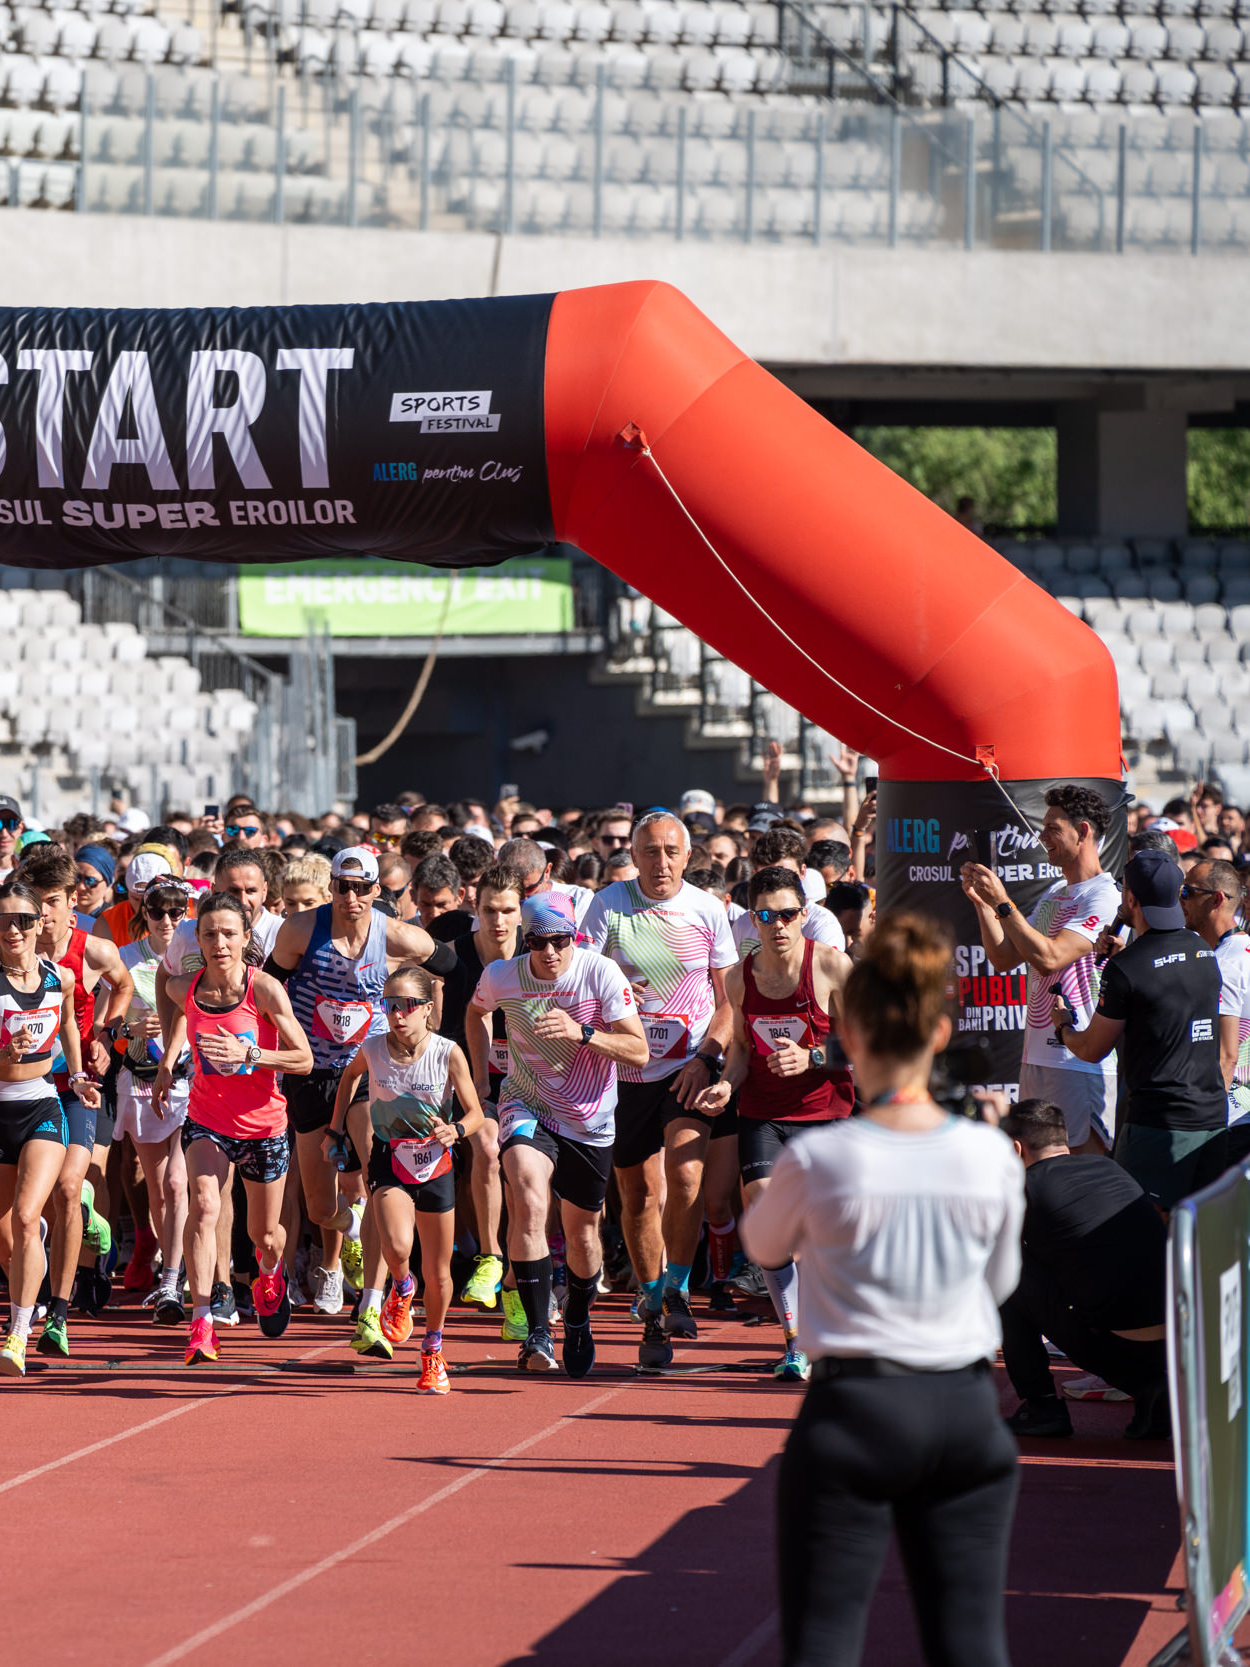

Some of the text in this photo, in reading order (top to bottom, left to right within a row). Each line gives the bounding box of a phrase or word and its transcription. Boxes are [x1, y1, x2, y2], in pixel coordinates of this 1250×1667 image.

[401, 396, 480, 414] SPORTS
[427, 417, 494, 430] FESTIVAL
[373, 461, 523, 483] ALERG pentru Cluj
[62, 501, 220, 529] SUPER
[231, 500, 357, 525] EROILOR
[887, 818, 940, 853] ALERG
[909, 865, 955, 882] CROSUL
[958, 976, 1027, 1007] PUBLI
[966, 1007, 981, 1018] DIN
[982, 1005, 1028, 1030] PRIV
[332, 1014, 351, 1026] 1918
[958, 1018, 981, 1031] BANI
[28, 1023, 44, 1034] 070
[649, 1027, 668, 1040] 1701
[769, 1028, 791, 1039] 1845
[495, 1050, 509, 1060] 181
